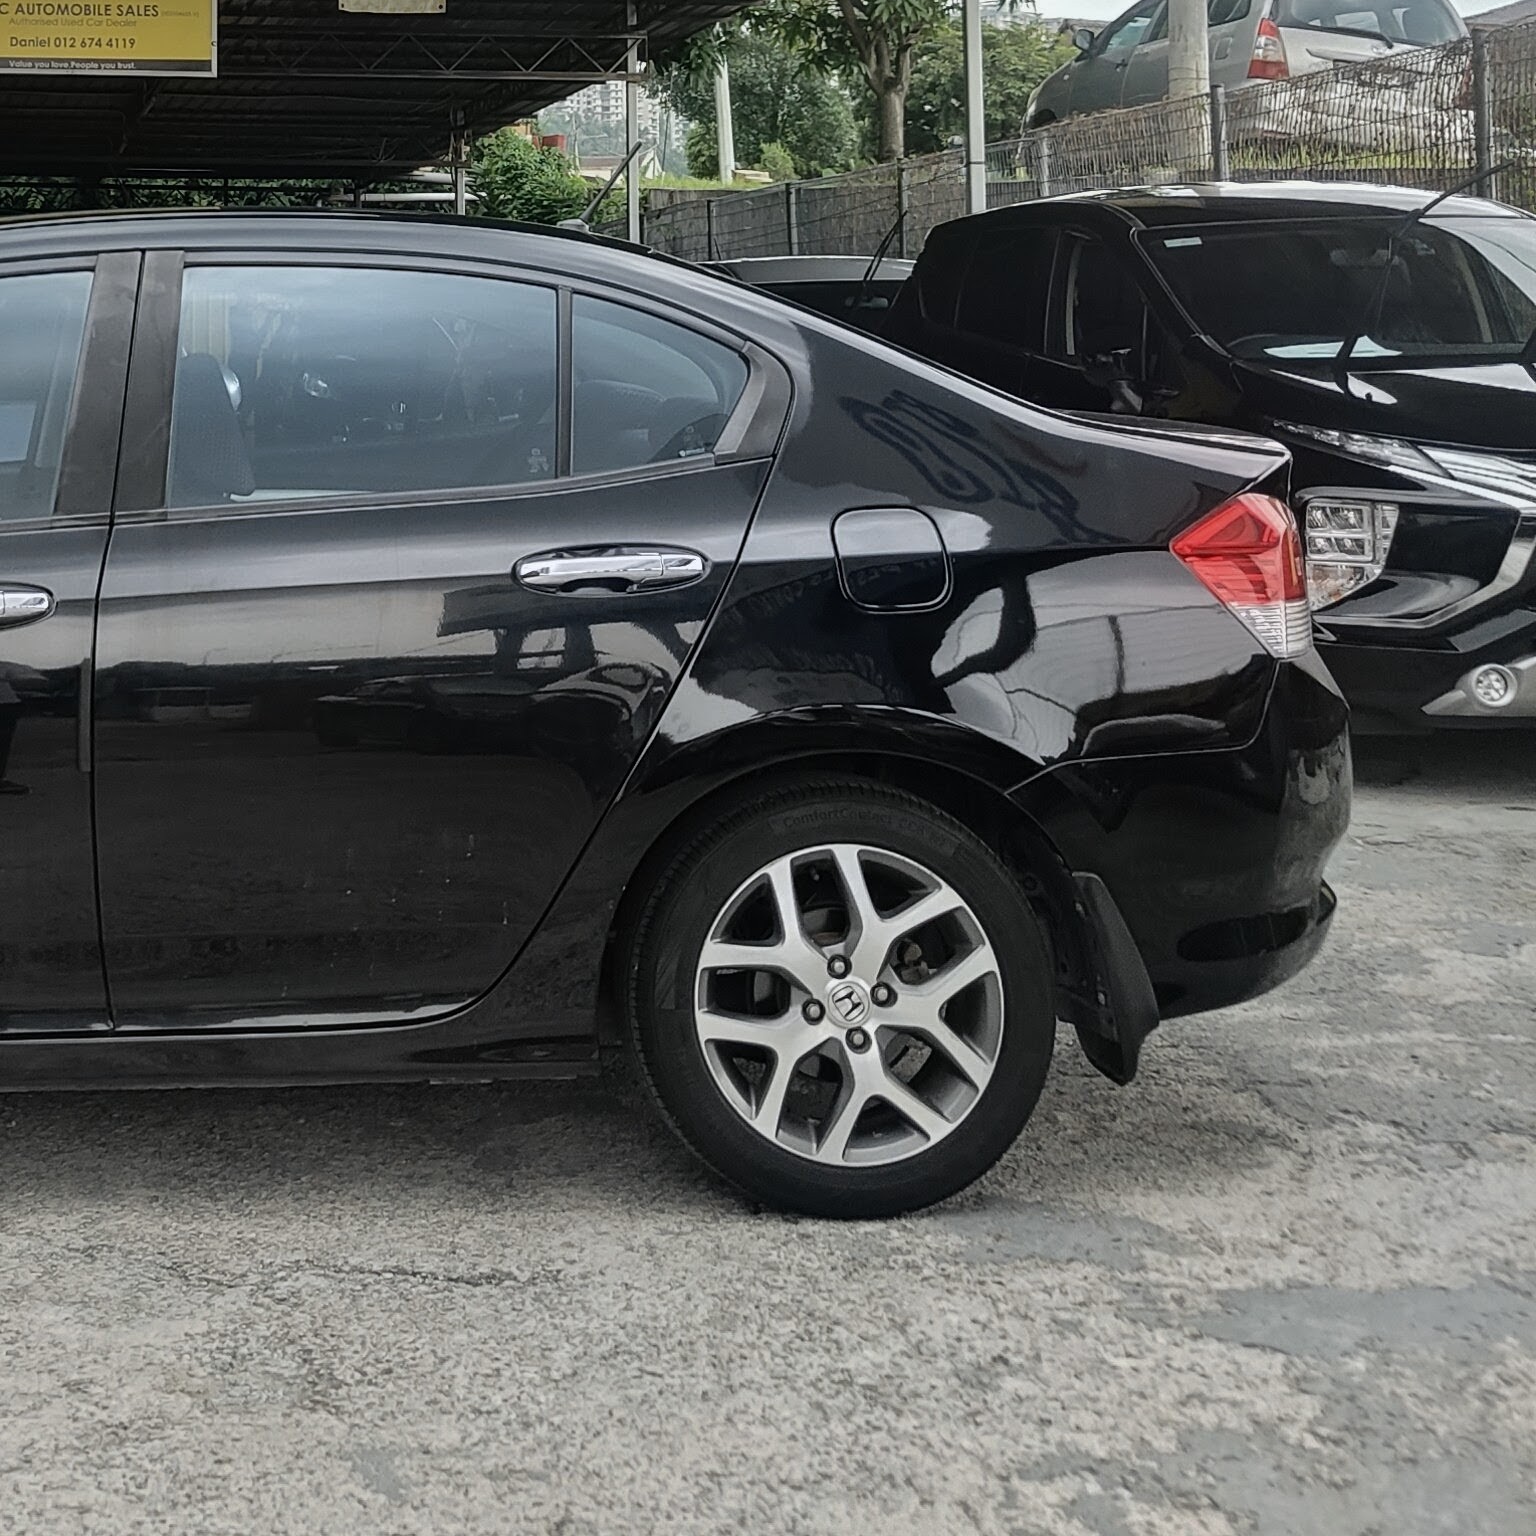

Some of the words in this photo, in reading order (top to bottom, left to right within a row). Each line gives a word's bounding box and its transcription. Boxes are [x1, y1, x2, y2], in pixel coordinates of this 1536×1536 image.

[15, 3, 112, 16] AUTOMOBILE
[116, 4, 159, 17] SALES
[61, 18, 83, 27] Used
[87, 18, 103, 27] Car
[106, 19, 137, 27] Dealer
[10, 36, 51, 48] Daniel
[54, 37, 76, 48] 012
[80, 38, 102, 48] 674
[106, 38, 136, 49] 4119
[9, 60, 32, 68] Value
[35, 61, 50, 69] you
[101, 63, 115, 71] you
